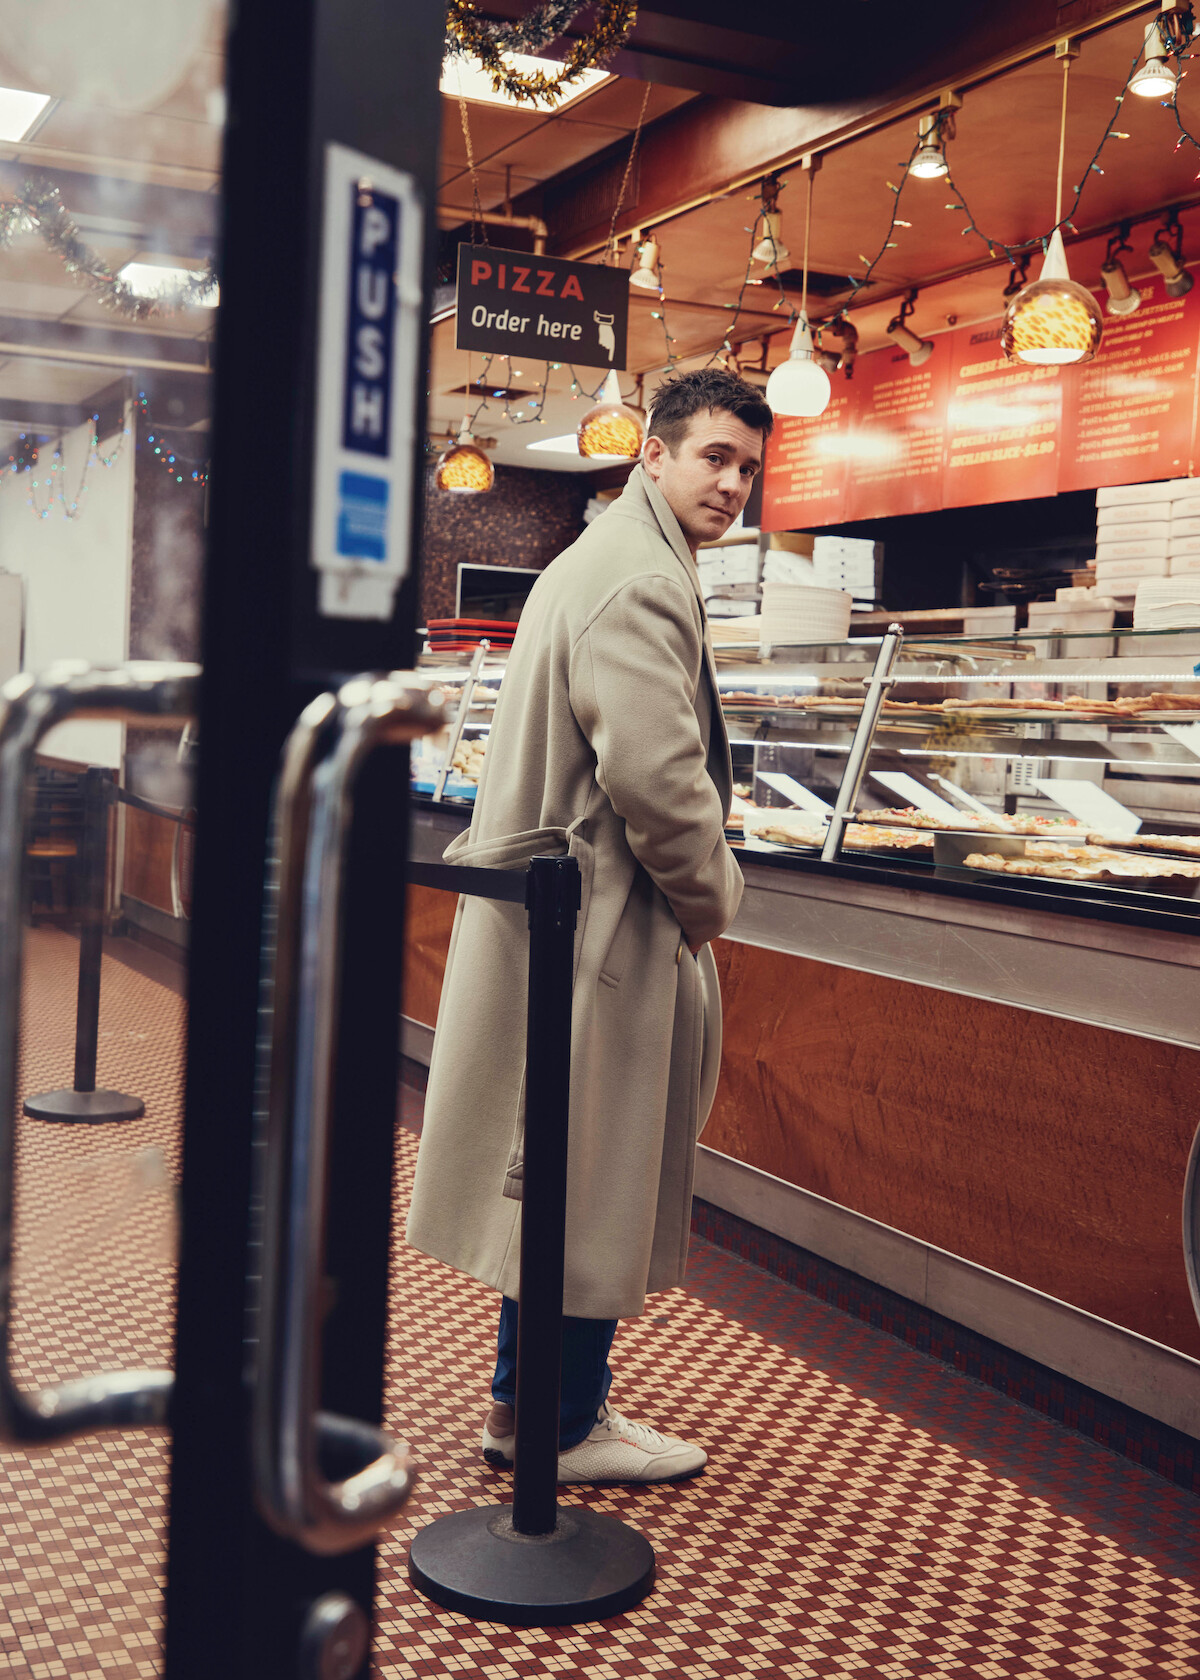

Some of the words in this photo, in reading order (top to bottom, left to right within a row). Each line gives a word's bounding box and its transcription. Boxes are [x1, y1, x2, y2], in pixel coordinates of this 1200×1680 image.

[471, 259, 585, 303] PIZZA
[349, 205, 391, 440] PUSH
[471, 305, 531, 334] Order
[536, 313, 583, 341] here
